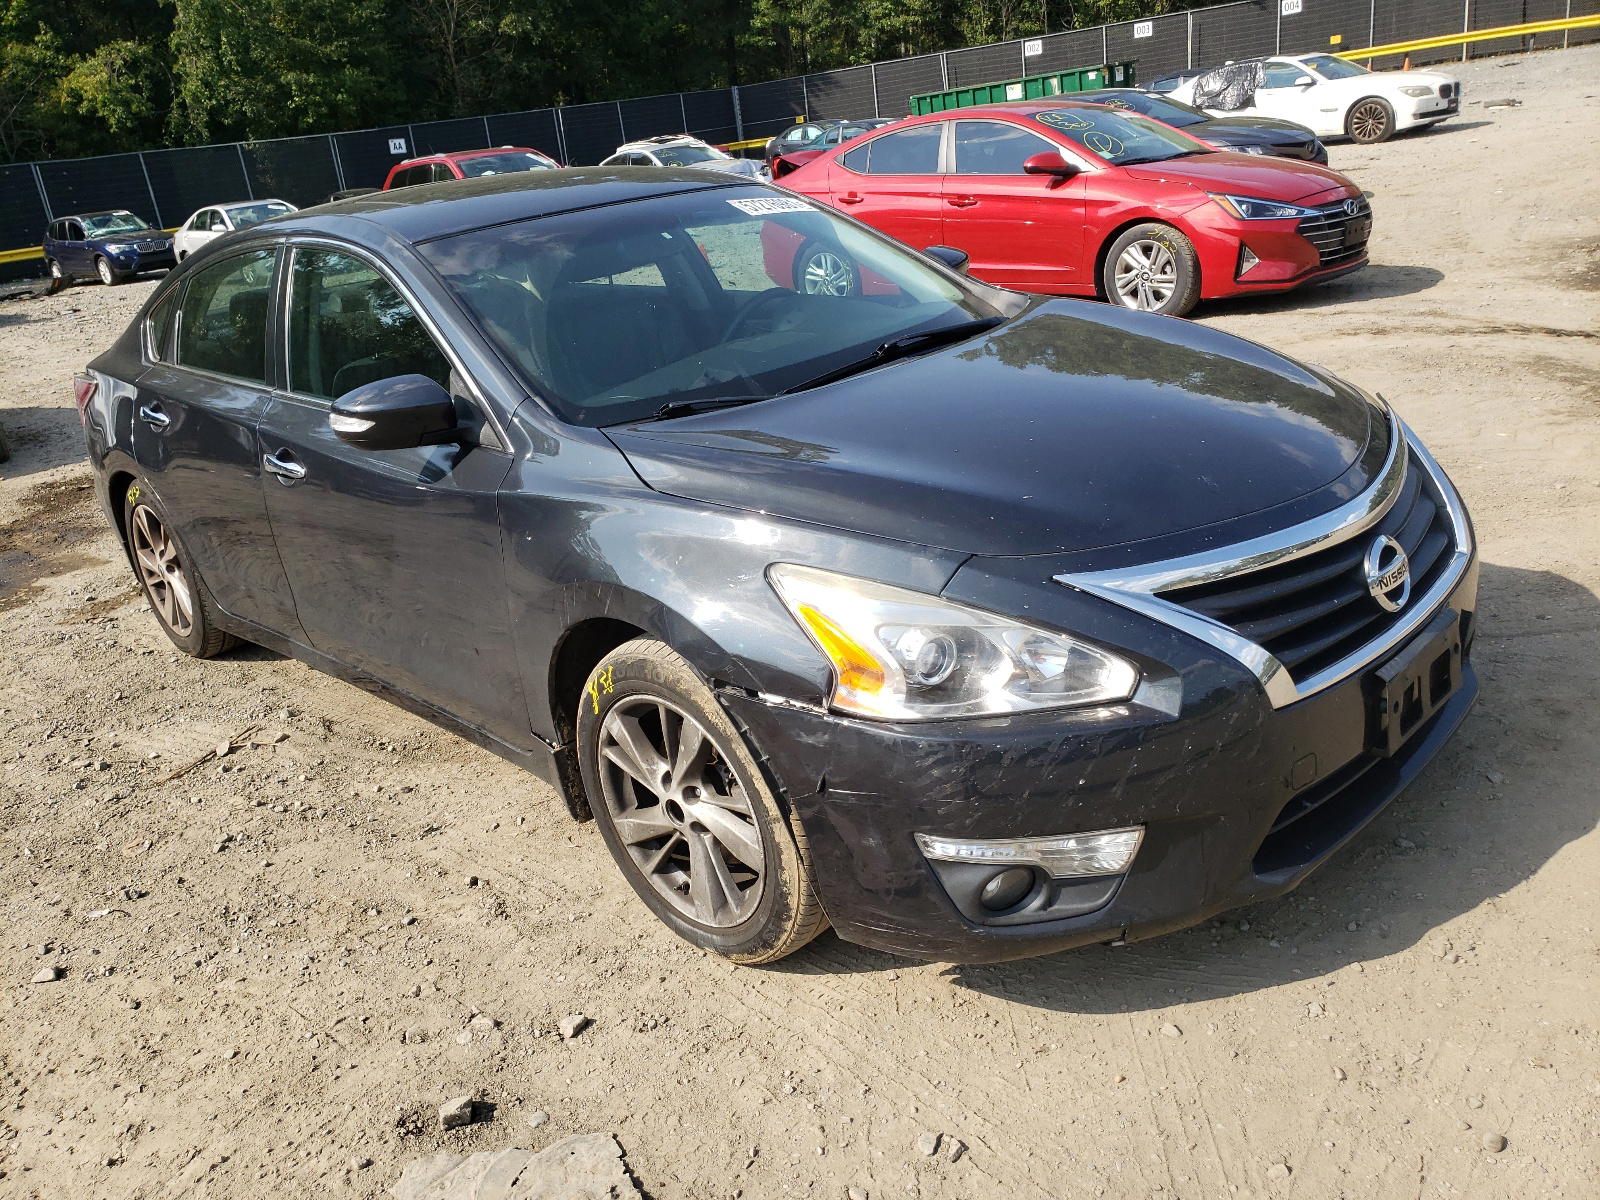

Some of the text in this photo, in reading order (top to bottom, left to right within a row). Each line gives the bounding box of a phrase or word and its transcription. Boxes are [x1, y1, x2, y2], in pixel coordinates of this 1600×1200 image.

[1285, 0, 1300, 11] 004
[1136, 25, 1150, 35] 003
[1026, 43, 1040, 53] 002
[393, 142, 404, 151] AA
